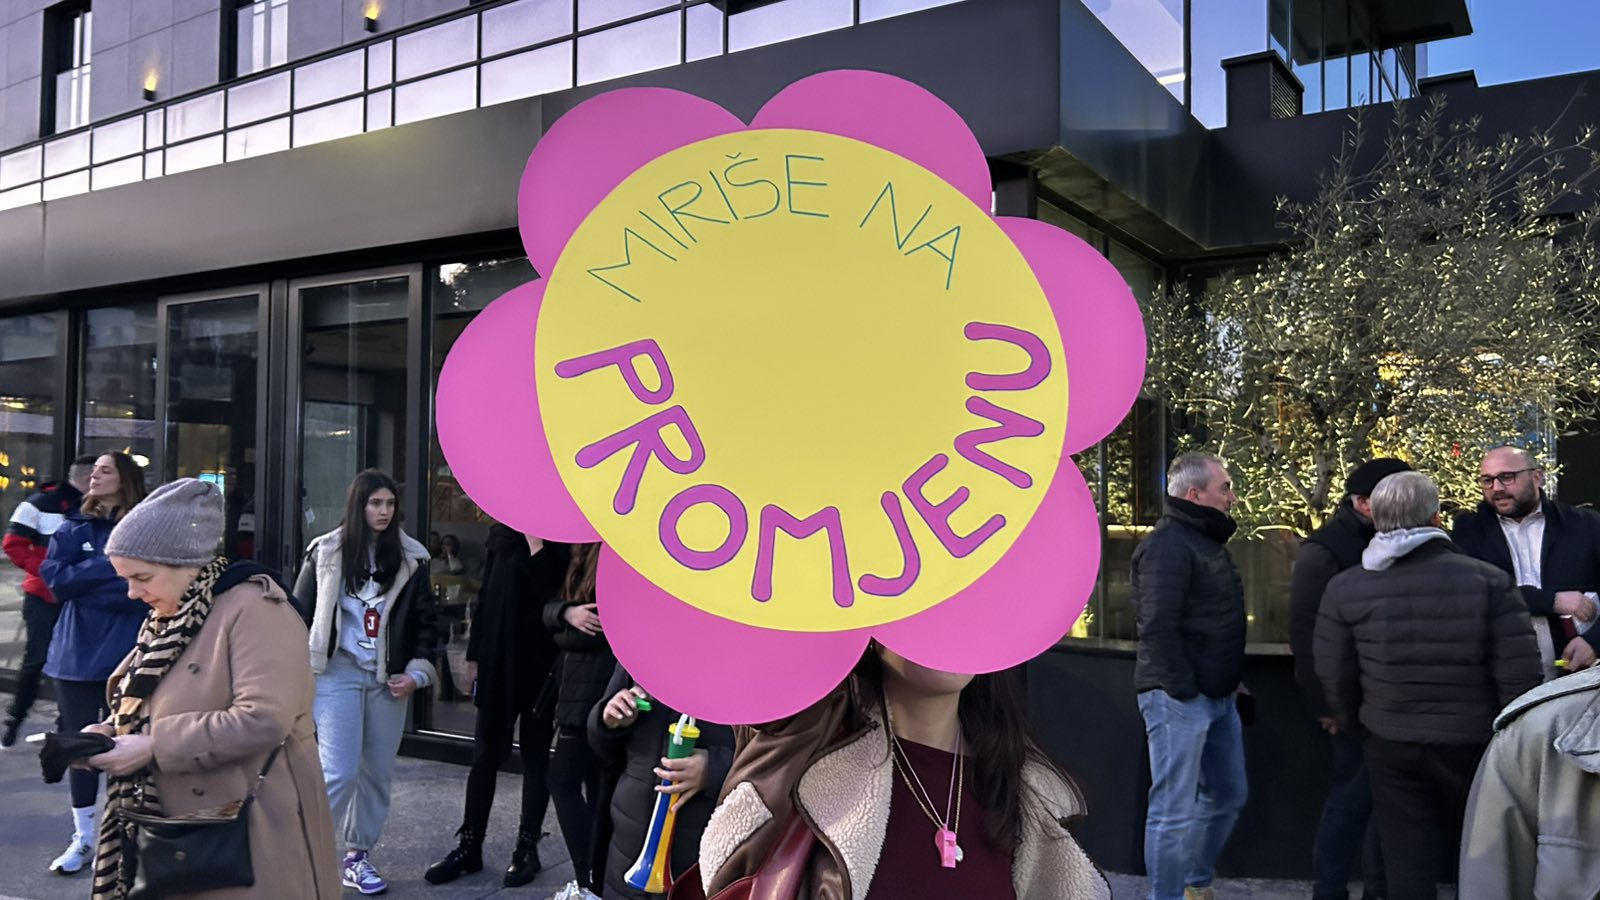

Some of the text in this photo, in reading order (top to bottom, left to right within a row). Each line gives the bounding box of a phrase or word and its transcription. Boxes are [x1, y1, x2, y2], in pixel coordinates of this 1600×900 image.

[587, 153, 961, 302] MIRIŠE NA
[555, 322, 1052, 607] PROMJENU
